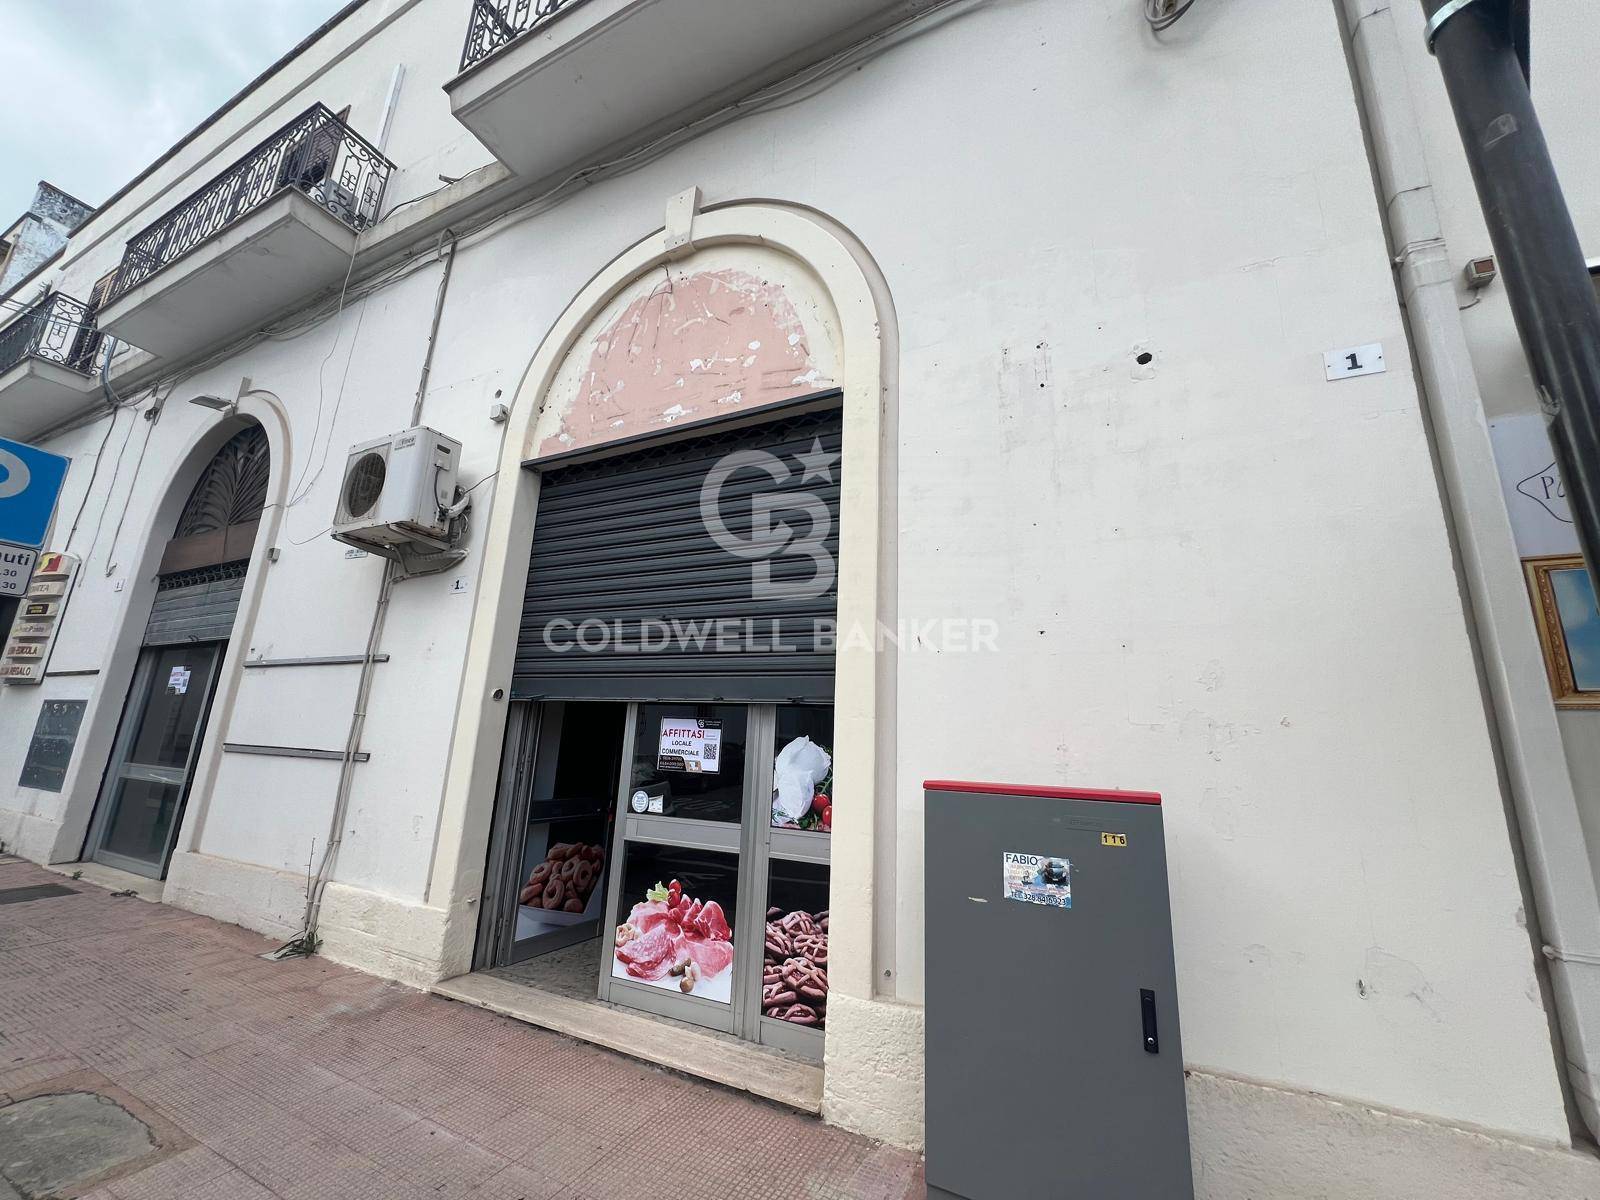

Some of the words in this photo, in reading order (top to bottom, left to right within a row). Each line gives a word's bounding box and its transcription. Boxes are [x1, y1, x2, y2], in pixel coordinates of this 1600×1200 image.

[1345, 353, 1363, 370] 1
[662, 728, 705, 738] AFFITTASI
[661, 748, 700, 756] COMMERCIALE
[1005, 853, 1038, 866] FABIO
